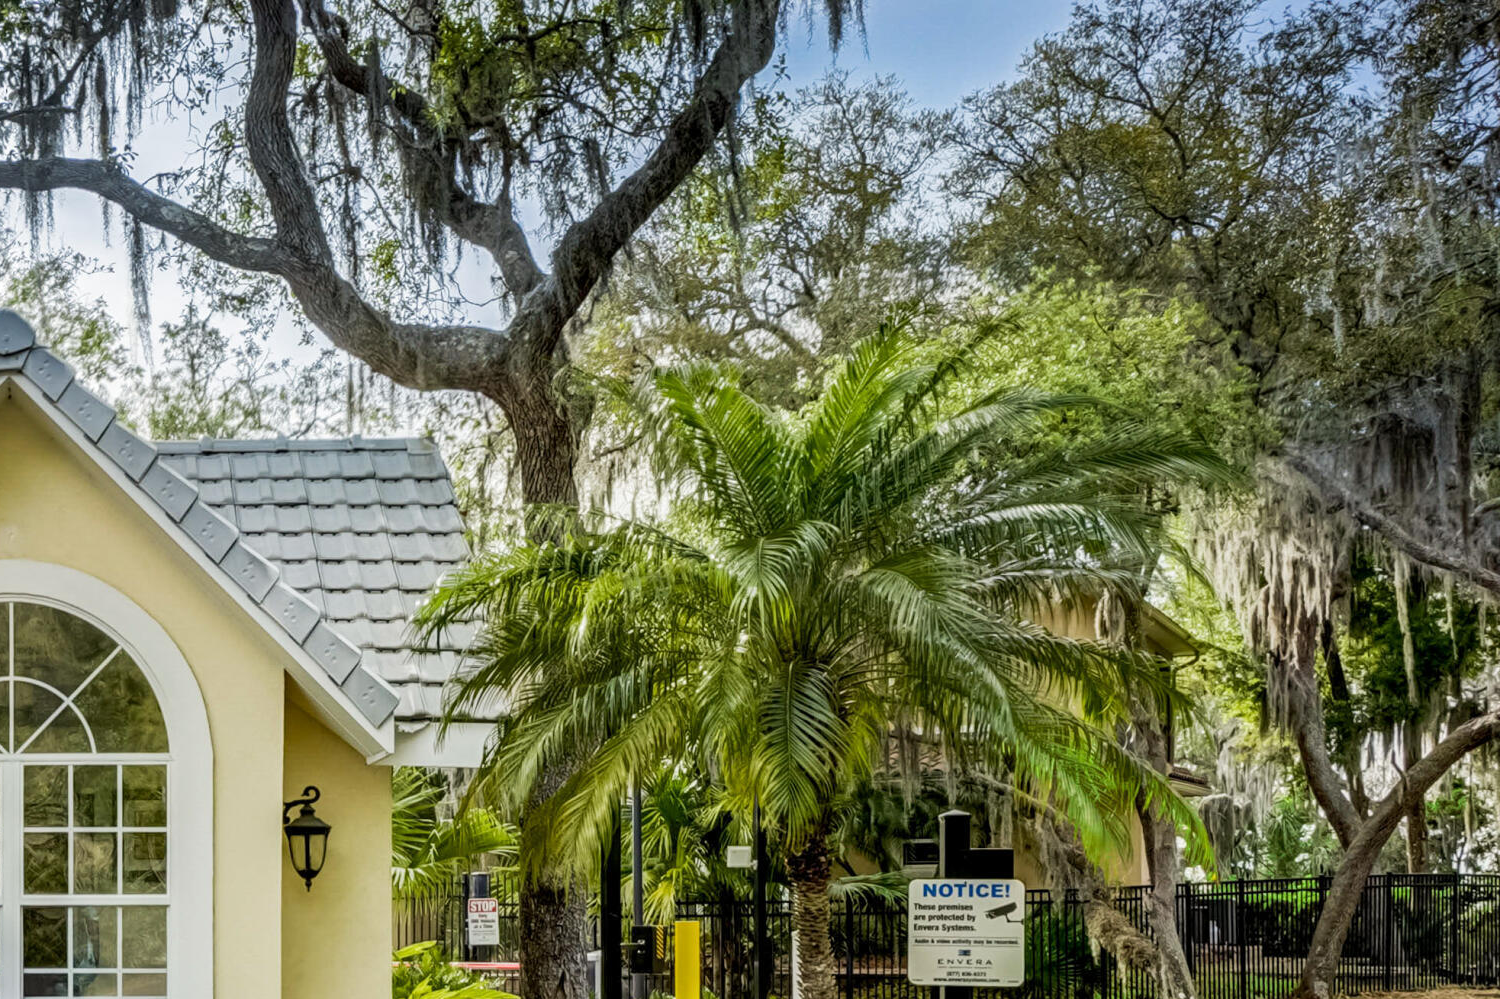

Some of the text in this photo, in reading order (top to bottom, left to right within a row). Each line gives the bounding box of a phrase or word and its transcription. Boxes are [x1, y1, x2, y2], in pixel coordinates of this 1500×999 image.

[923, 883, 1010, 898] NOTICE!
[470, 901, 496, 912] STOP
[913, 903, 973, 911] These premises
[928, 914, 965, 922] protected
[967, 914, 976, 922] by
[941, 924, 977, 932] Systems.
